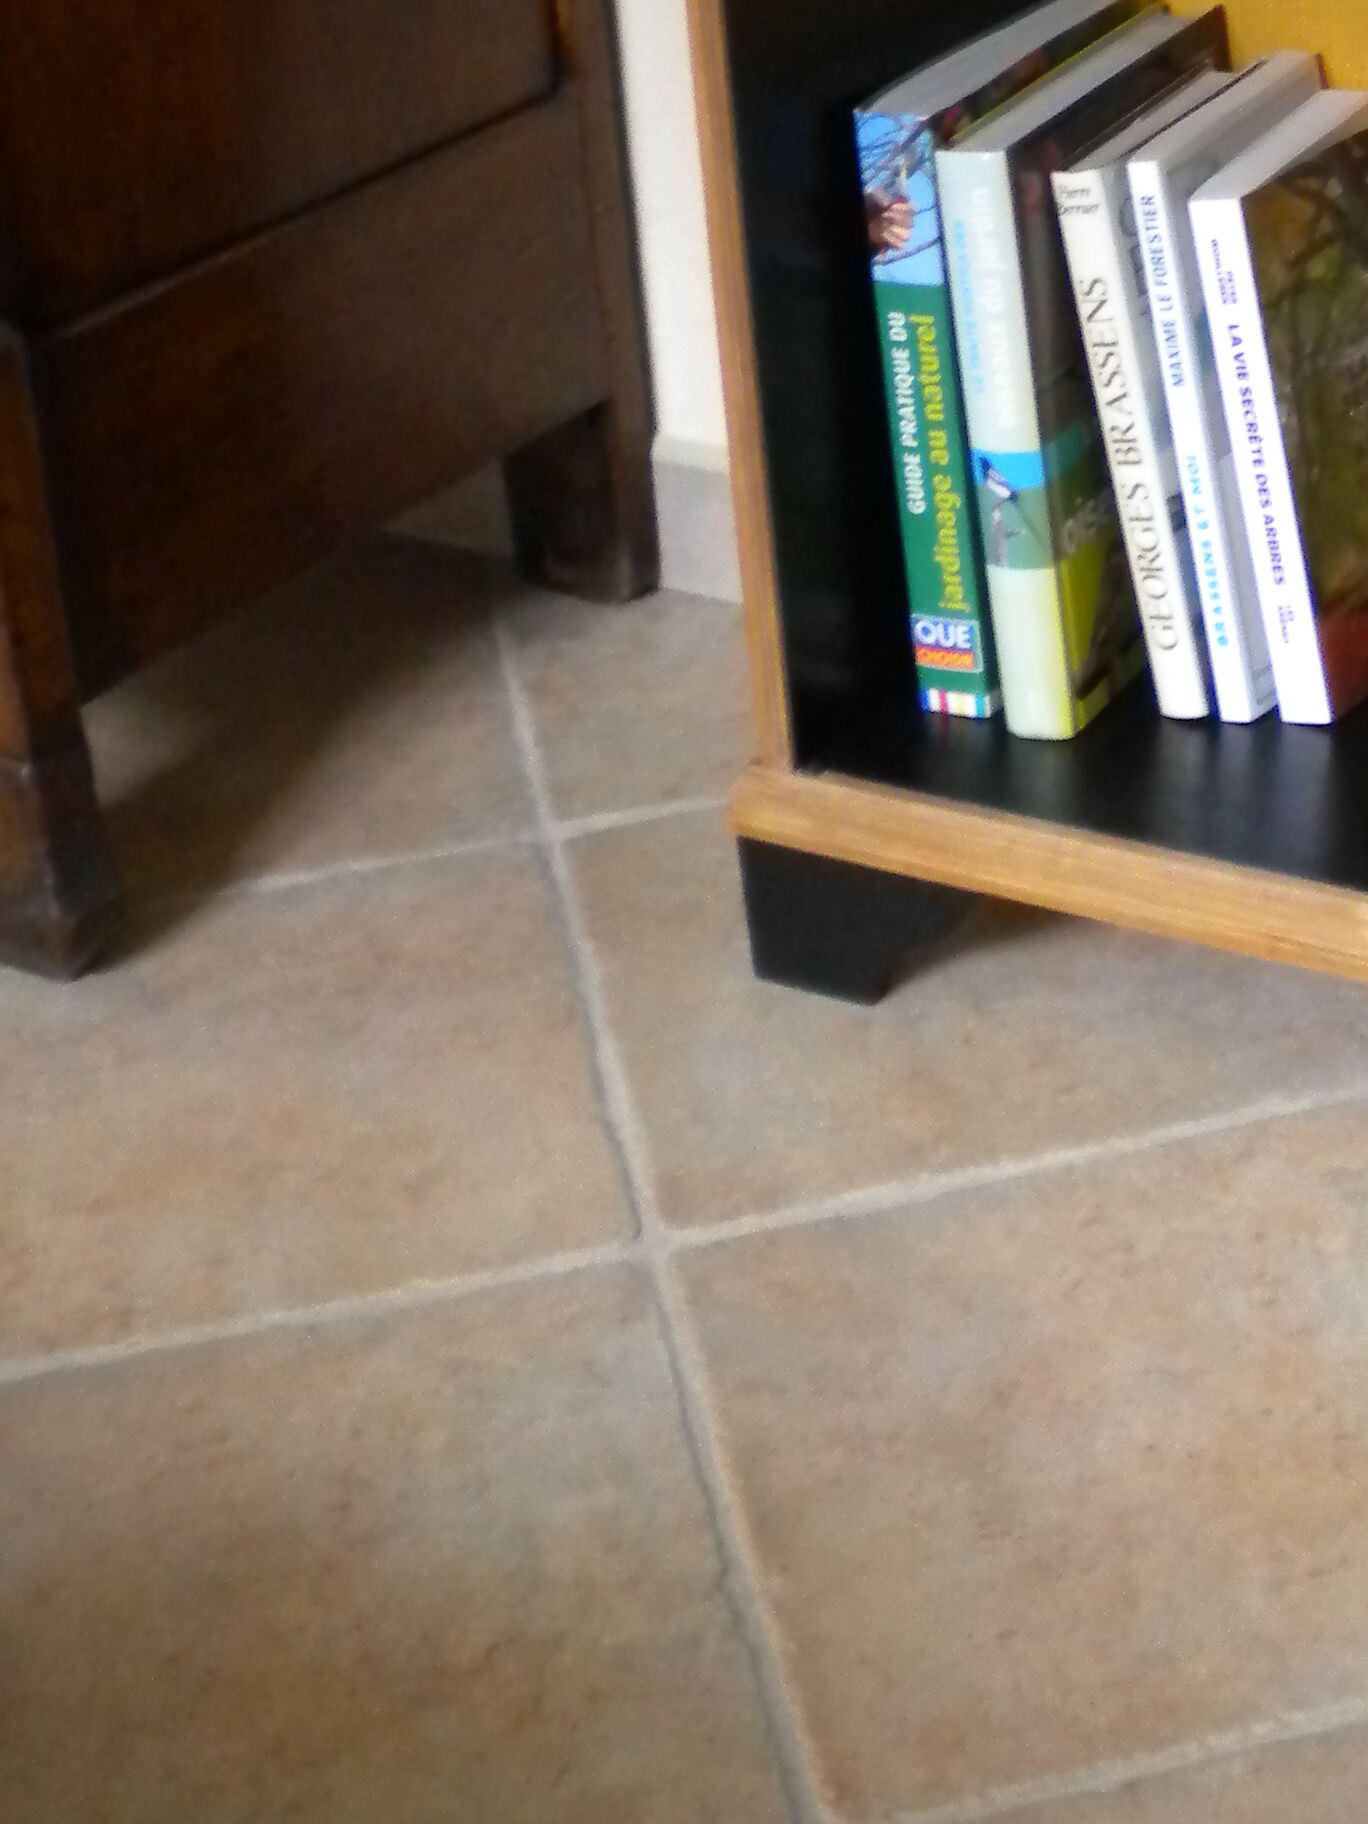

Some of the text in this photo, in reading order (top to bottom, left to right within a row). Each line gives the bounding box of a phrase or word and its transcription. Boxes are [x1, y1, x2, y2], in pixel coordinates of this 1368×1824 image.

[908, 314, 945, 422] naturel
[1079, 277, 1142, 466] BRASSENS
[1140, 195, 1185, 387] MAXIME LE FORESTIER
[887, 311, 927, 515] GUIDE PRATIQUE DU
[928, 429, 949, 465] au
[1227, 324, 1286, 585] LA VIE SECRÈTE DES ARBRES
[932, 474, 970, 612] jardinage
[1121, 483, 1179, 651] GEORGES
[1187, 455, 1228, 646] BRASSENS ET MOI
